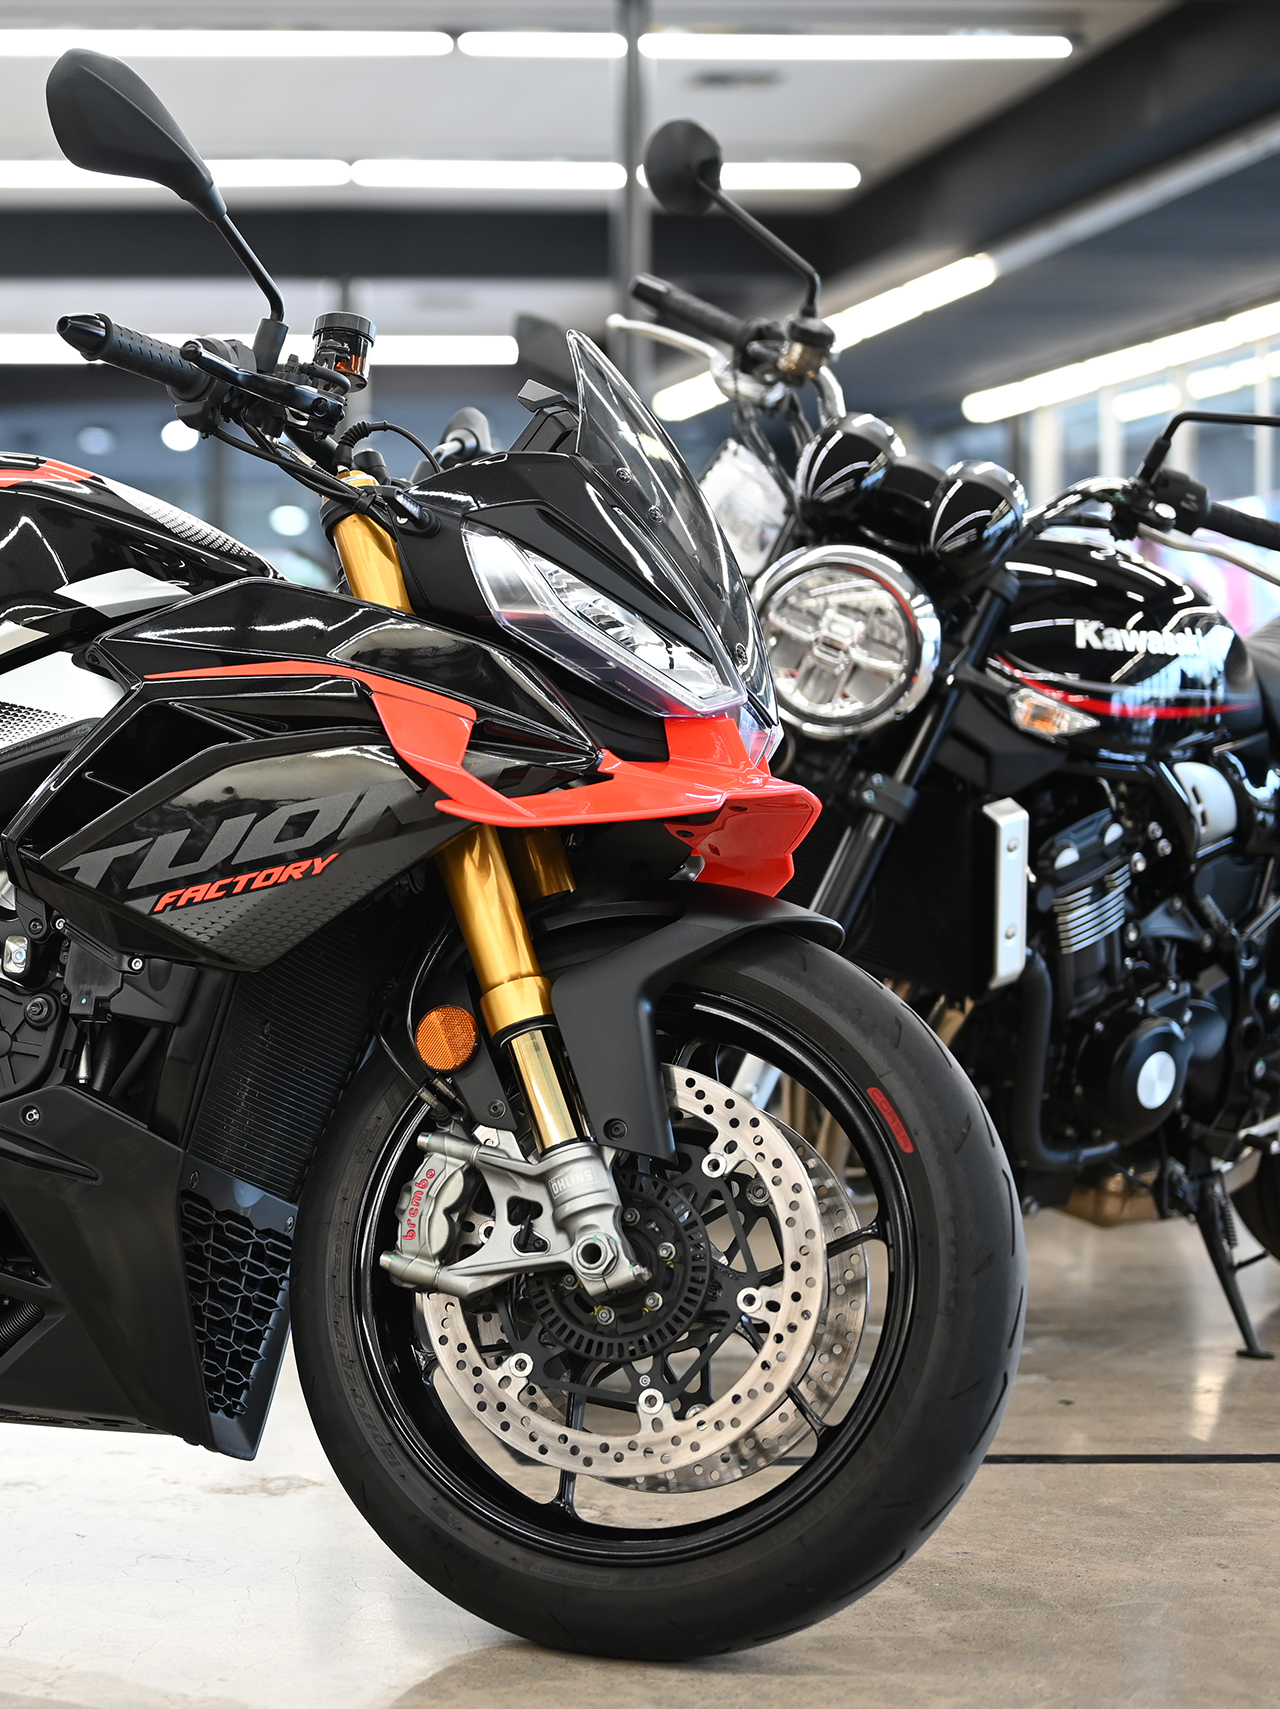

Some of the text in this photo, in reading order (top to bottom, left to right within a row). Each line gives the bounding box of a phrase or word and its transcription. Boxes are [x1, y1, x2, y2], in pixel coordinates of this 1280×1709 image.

[1074, 618, 1204, 657] Kawasaki
[153, 852, 340, 912] FACTORY
[870, 1088, 910, 1149] CORSA
[402, 1168, 436, 1240] brembo
[551, 1169, 594, 1195] ÖHLINS
[539, 1563, 610, 1585] CORSA
